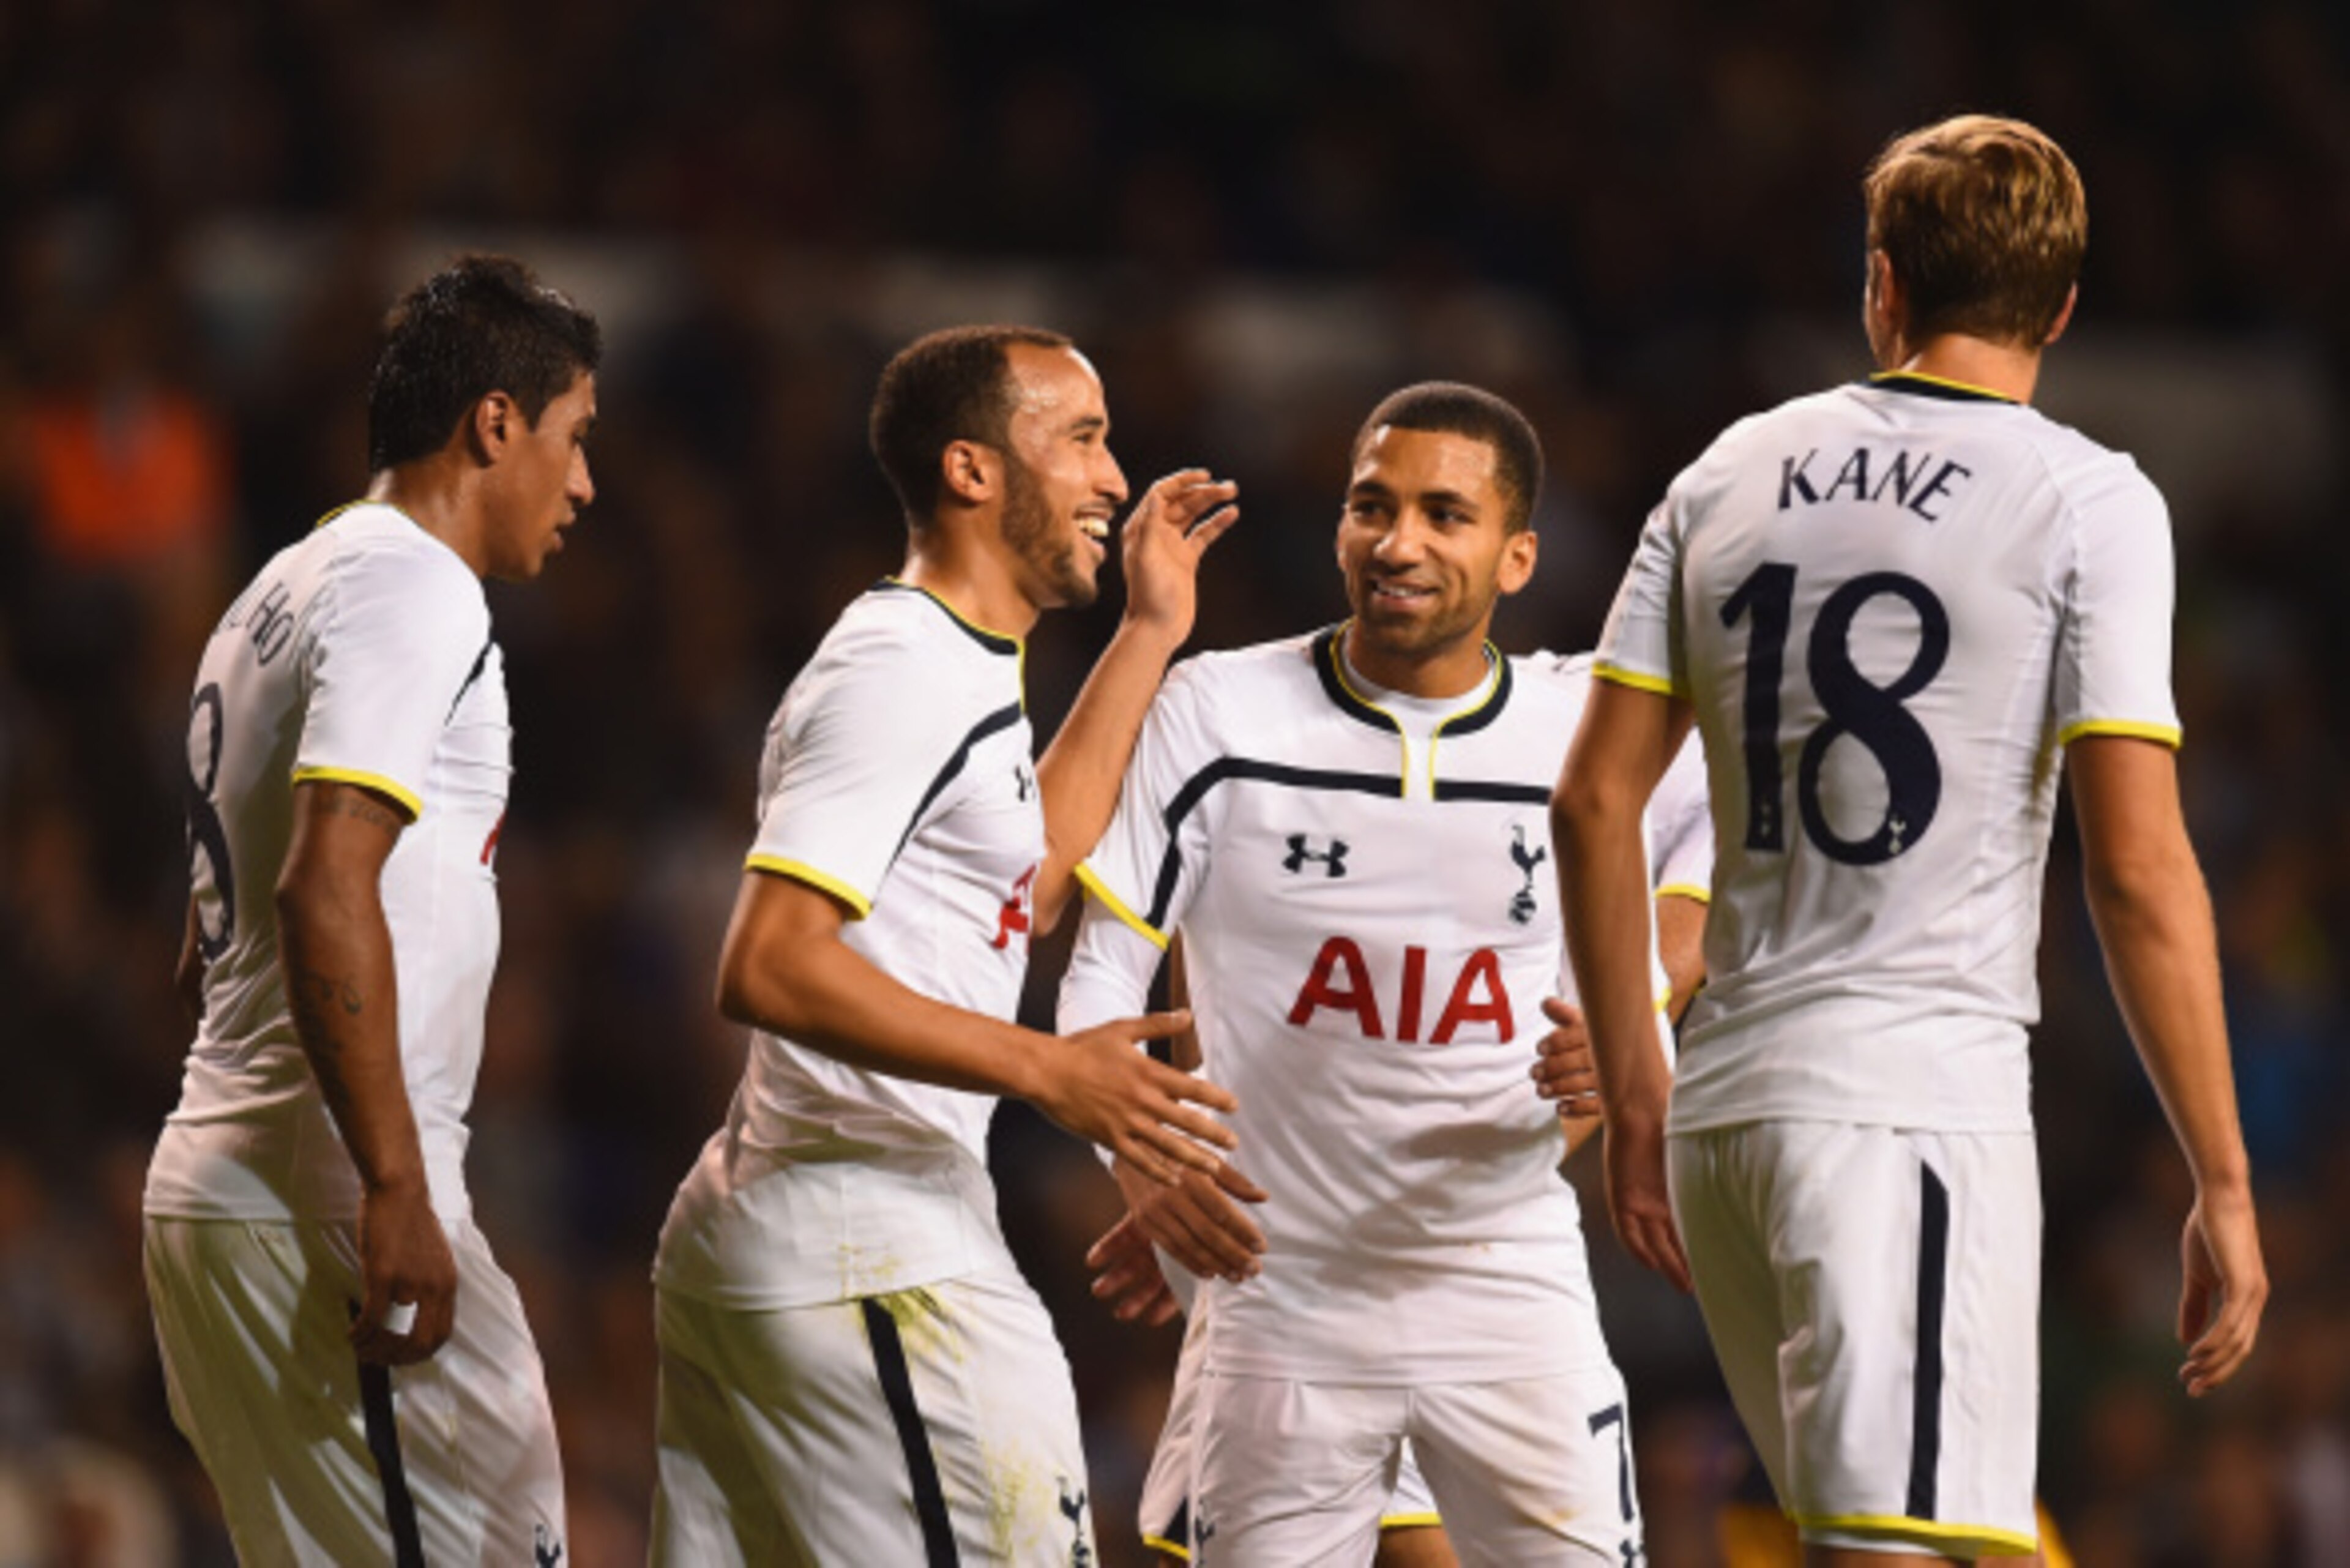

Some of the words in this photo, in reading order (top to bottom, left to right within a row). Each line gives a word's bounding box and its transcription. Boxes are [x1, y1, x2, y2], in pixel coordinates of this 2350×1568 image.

[1778, 447, 1972, 523] KANE
[1718, 561, 1950, 867] 18
[186, 681, 236, 963] 8
[1287, 936, 1516, 1045] AIA
[1587, 1402, 1634, 1523] 7
